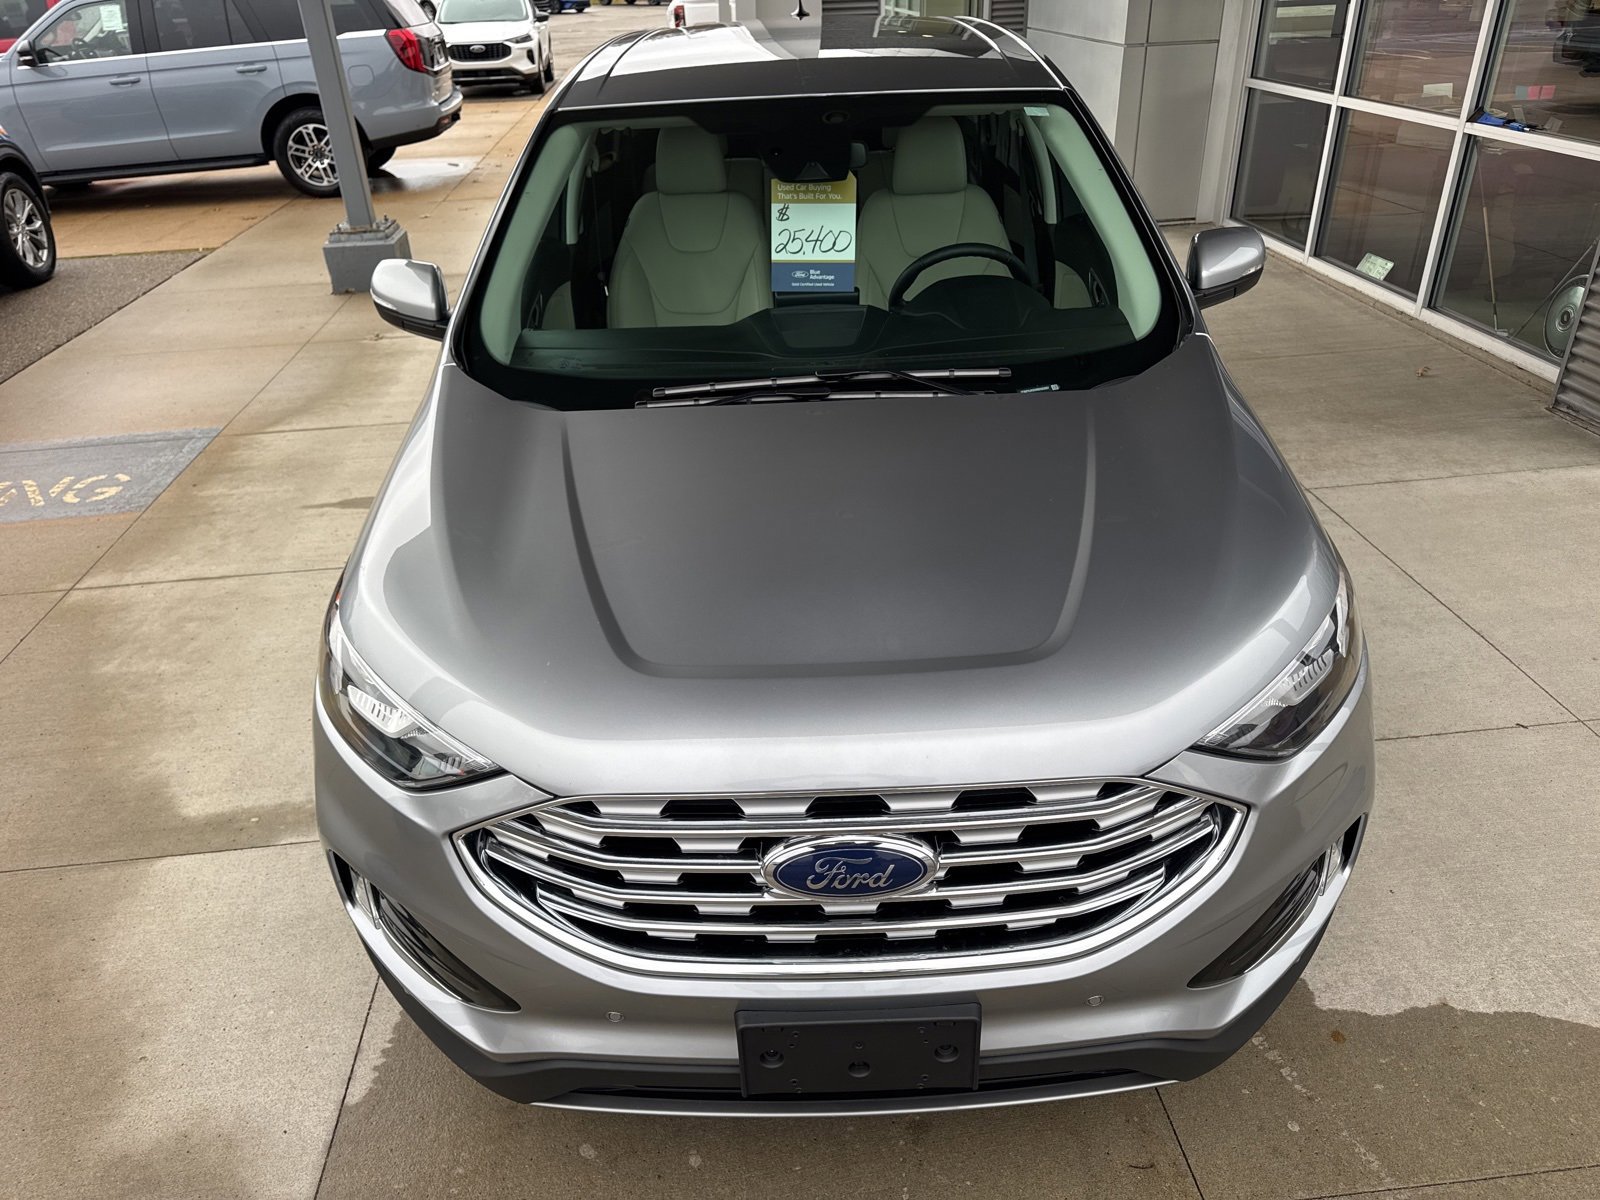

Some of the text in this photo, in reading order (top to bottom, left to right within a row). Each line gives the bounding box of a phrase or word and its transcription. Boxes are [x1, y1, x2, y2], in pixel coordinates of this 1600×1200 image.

[808, 184, 832, 192] Buying
[777, 192, 798, 200] That's
[799, 192, 814, 200] Built
[815, 192, 827, 200] For
[776, 203, 790, 222] $
[805, 856, 896, 891] Ford
